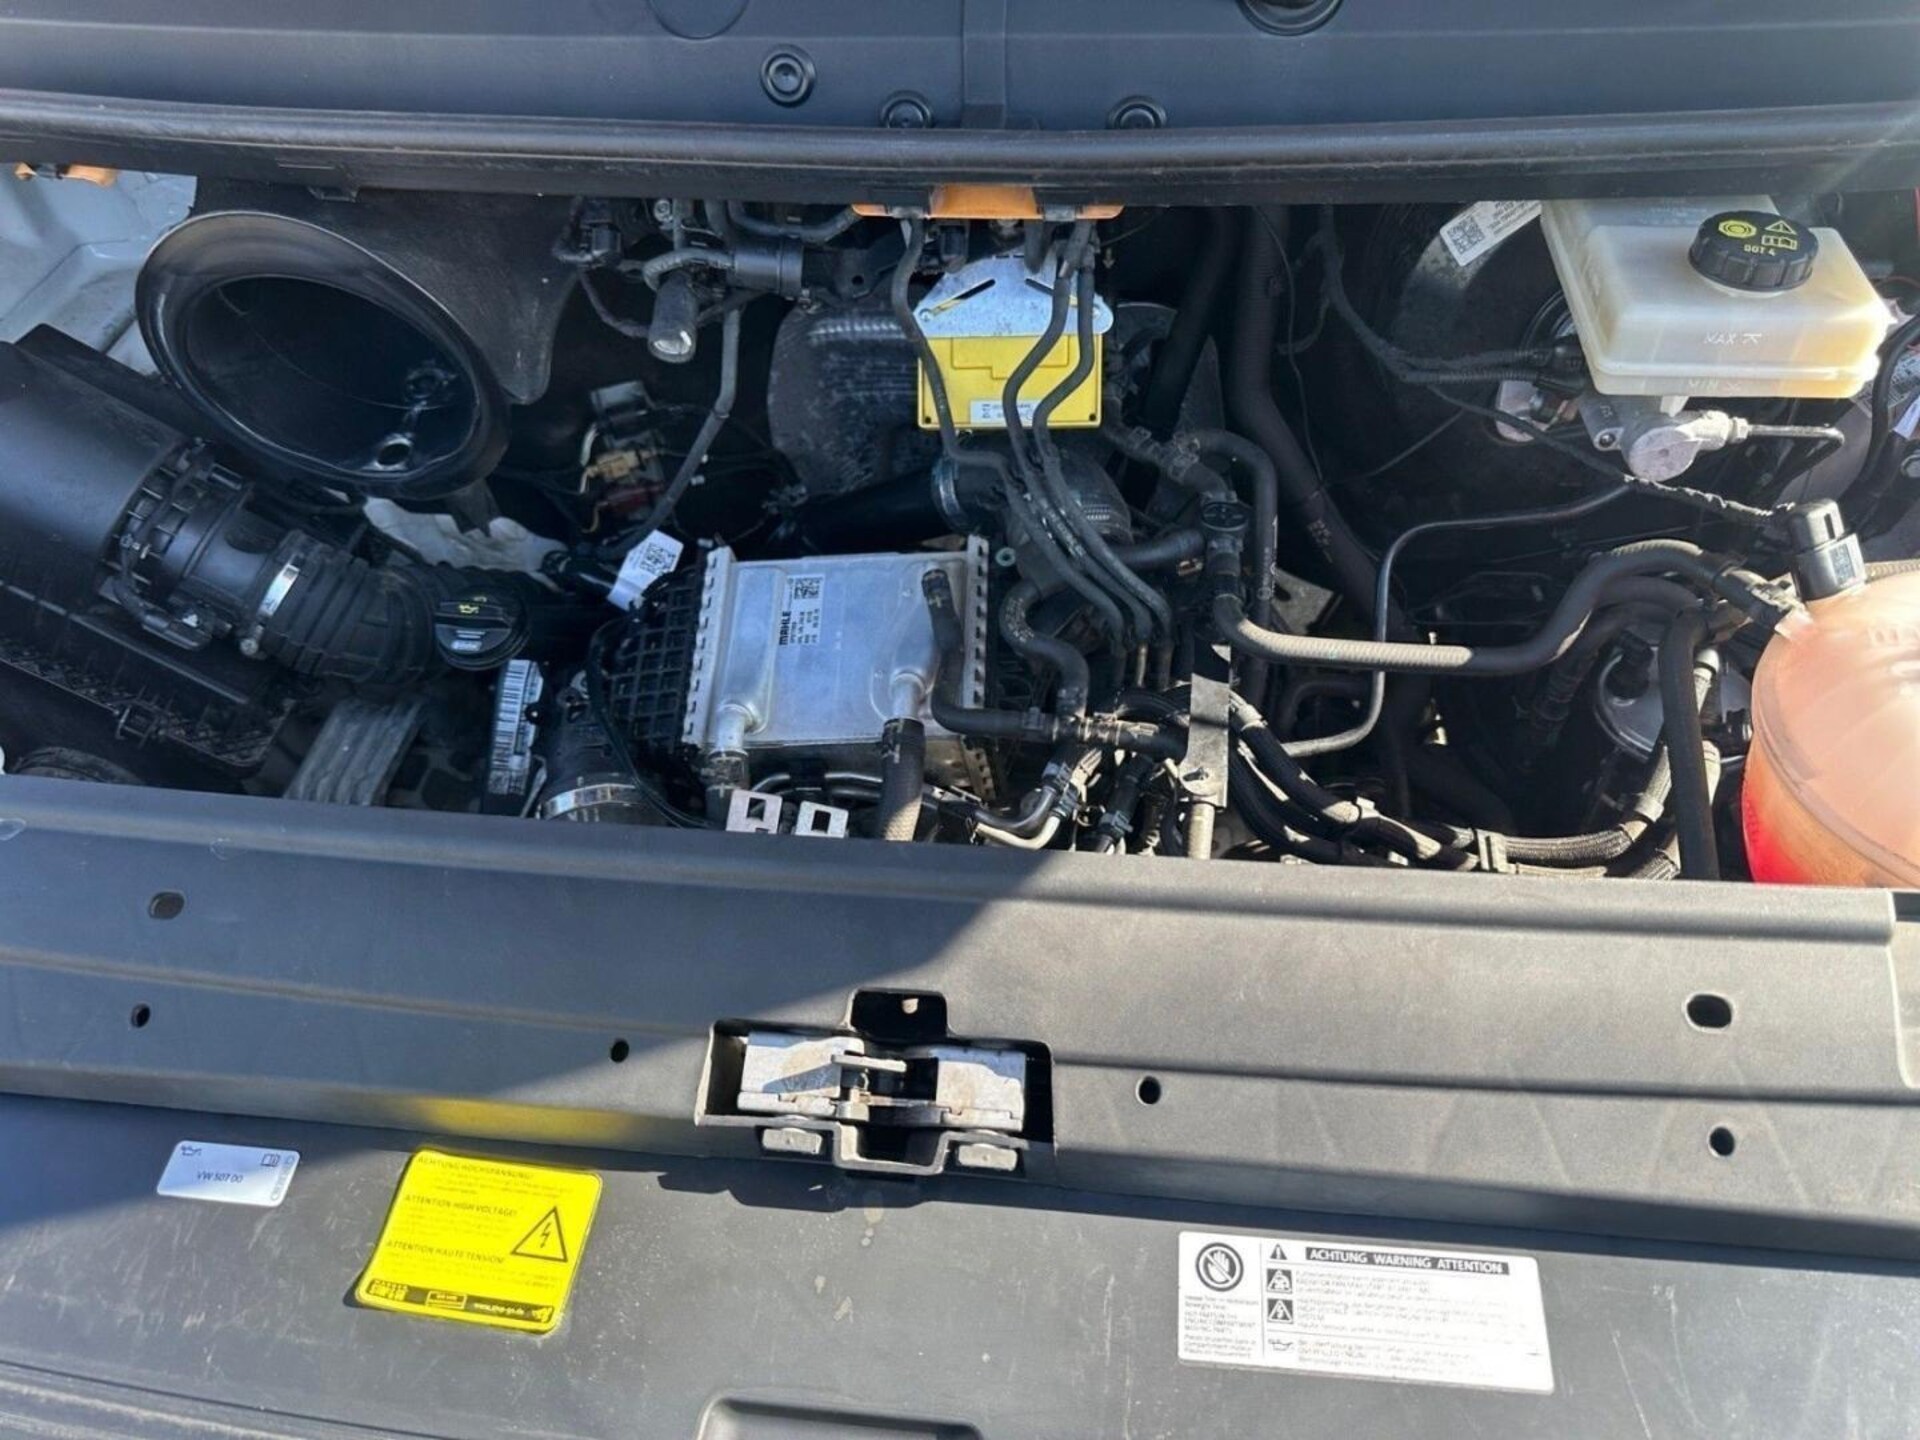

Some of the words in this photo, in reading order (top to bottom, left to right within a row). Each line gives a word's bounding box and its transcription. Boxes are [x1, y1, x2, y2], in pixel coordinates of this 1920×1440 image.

[1743, 243, 1766, 254] DOT
[1768, 247, 1776, 257] 4
[1703, 331, 1737, 345] MAX
[779, 611, 792, 645] MAHLE
[197, 1170, 214, 1181] VW
[230, 1173, 244, 1184] 00
[404, 1194, 451, 1208] ATTENTION
[386, 1239, 434, 1255] ATTENTION
[1309, 1248, 1369, 1265] ACHTUNG
[1373, 1252, 1433, 1269] WARNING
[1437, 1257, 1504, 1274] ATTENTION
